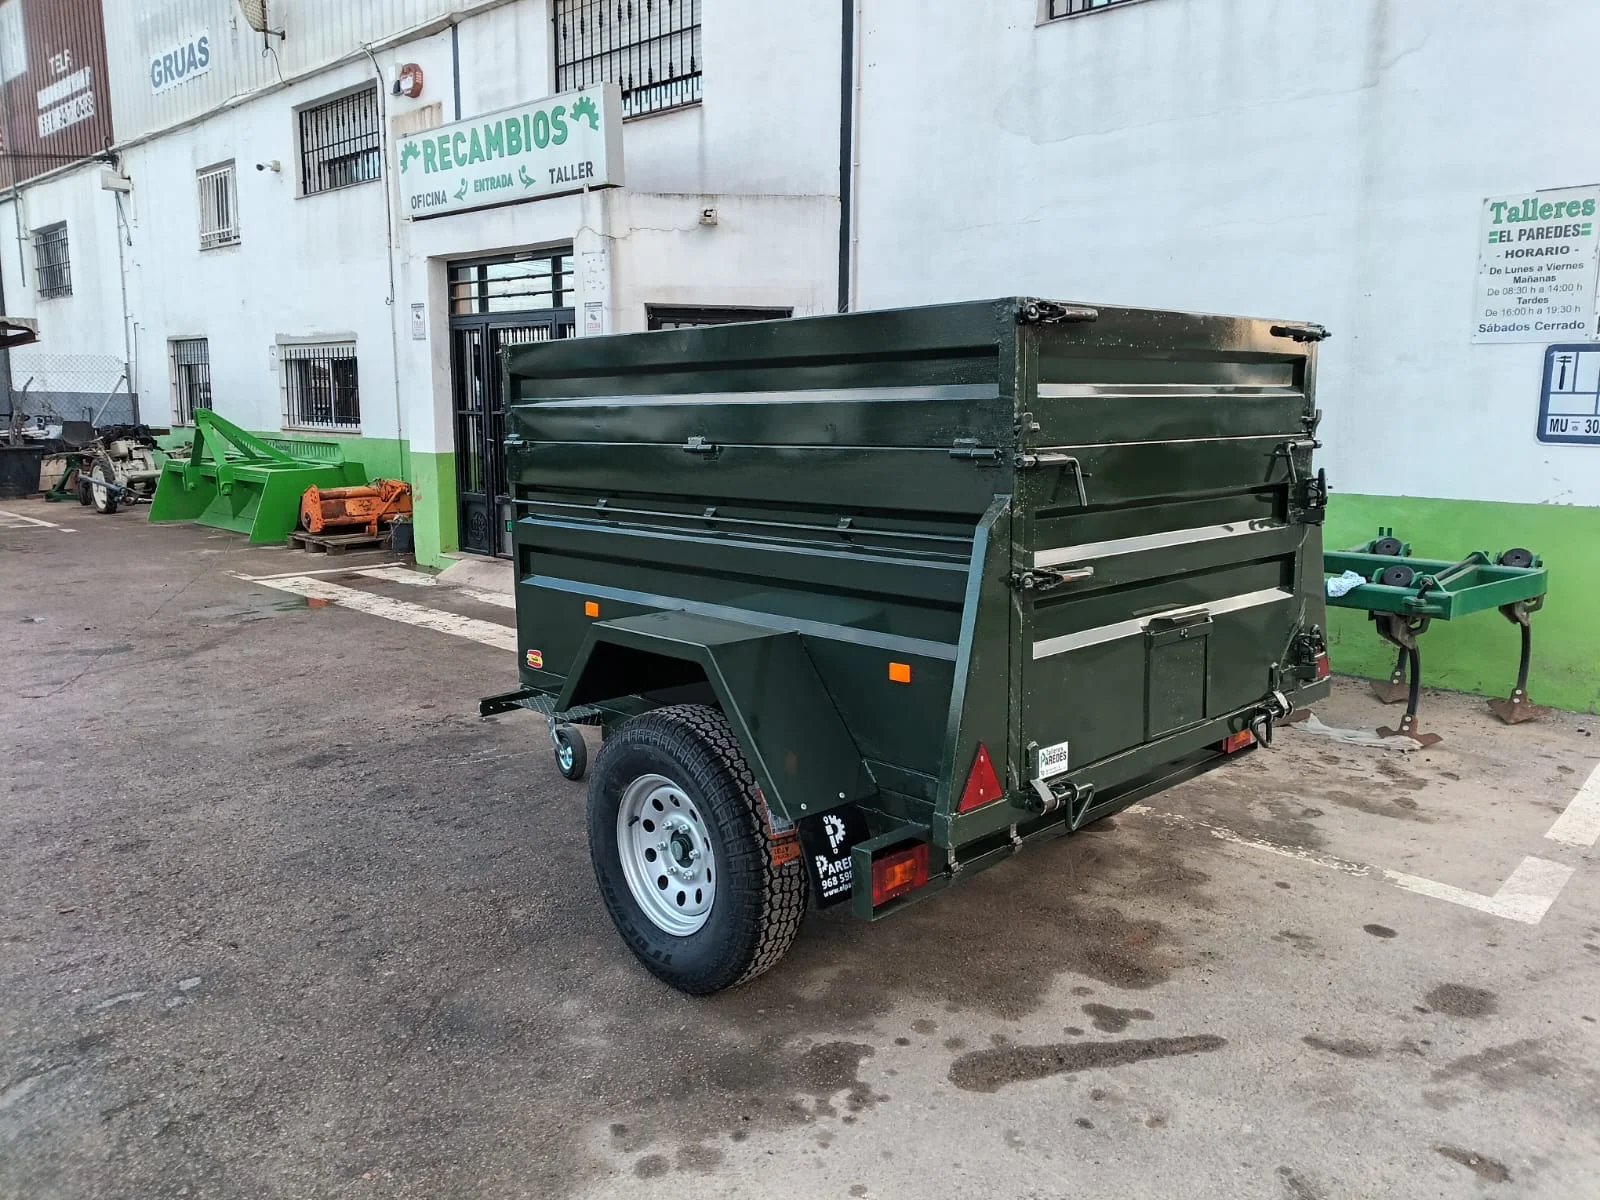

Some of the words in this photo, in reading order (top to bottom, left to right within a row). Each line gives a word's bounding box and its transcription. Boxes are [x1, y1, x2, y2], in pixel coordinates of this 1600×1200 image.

[151, 36, 210, 88] GRUAS
[422, 105, 568, 174] RECAMBIOS
[549, 161, 594, 185] TALLER
[474, 172, 514, 193] ENTRADA
[410, 189, 447, 210] OFICINA
[1490, 197, 1596, 224] Talleres
[1498, 230, 1513, 243] EL
[1518, 224, 1581, 242] PAREDES
[1504, 245, 1570, 259] HORARIO
[1489, 266, 1502, 275] De
[1505, 264, 1534, 274] Lunes
[1546, 262, 1584, 271] Viernes
[1513, 274, 1556, 284] Mañanas
[1487, 287, 1500, 296] De
[1502, 286, 1527, 296] 08:30
[1548, 283, 1574, 293] 14:00
[1516, 296, 1549, 305] Tardes
[1485, 308, 1497, 317] De
[1501, 307, 1526, 317] 16:00
[1546, 305, 1572, 315] 19:30
[1478, 322, 1530, 333] Sábados
[1534, 320, 1585, 331] Cerrado
[1549, 418, 1569, 433] MU
[1585, 419, 1600, 434] 30
[1040, 751, 1067, 768] PAREDES
[821, 876, 838, 890] 968
